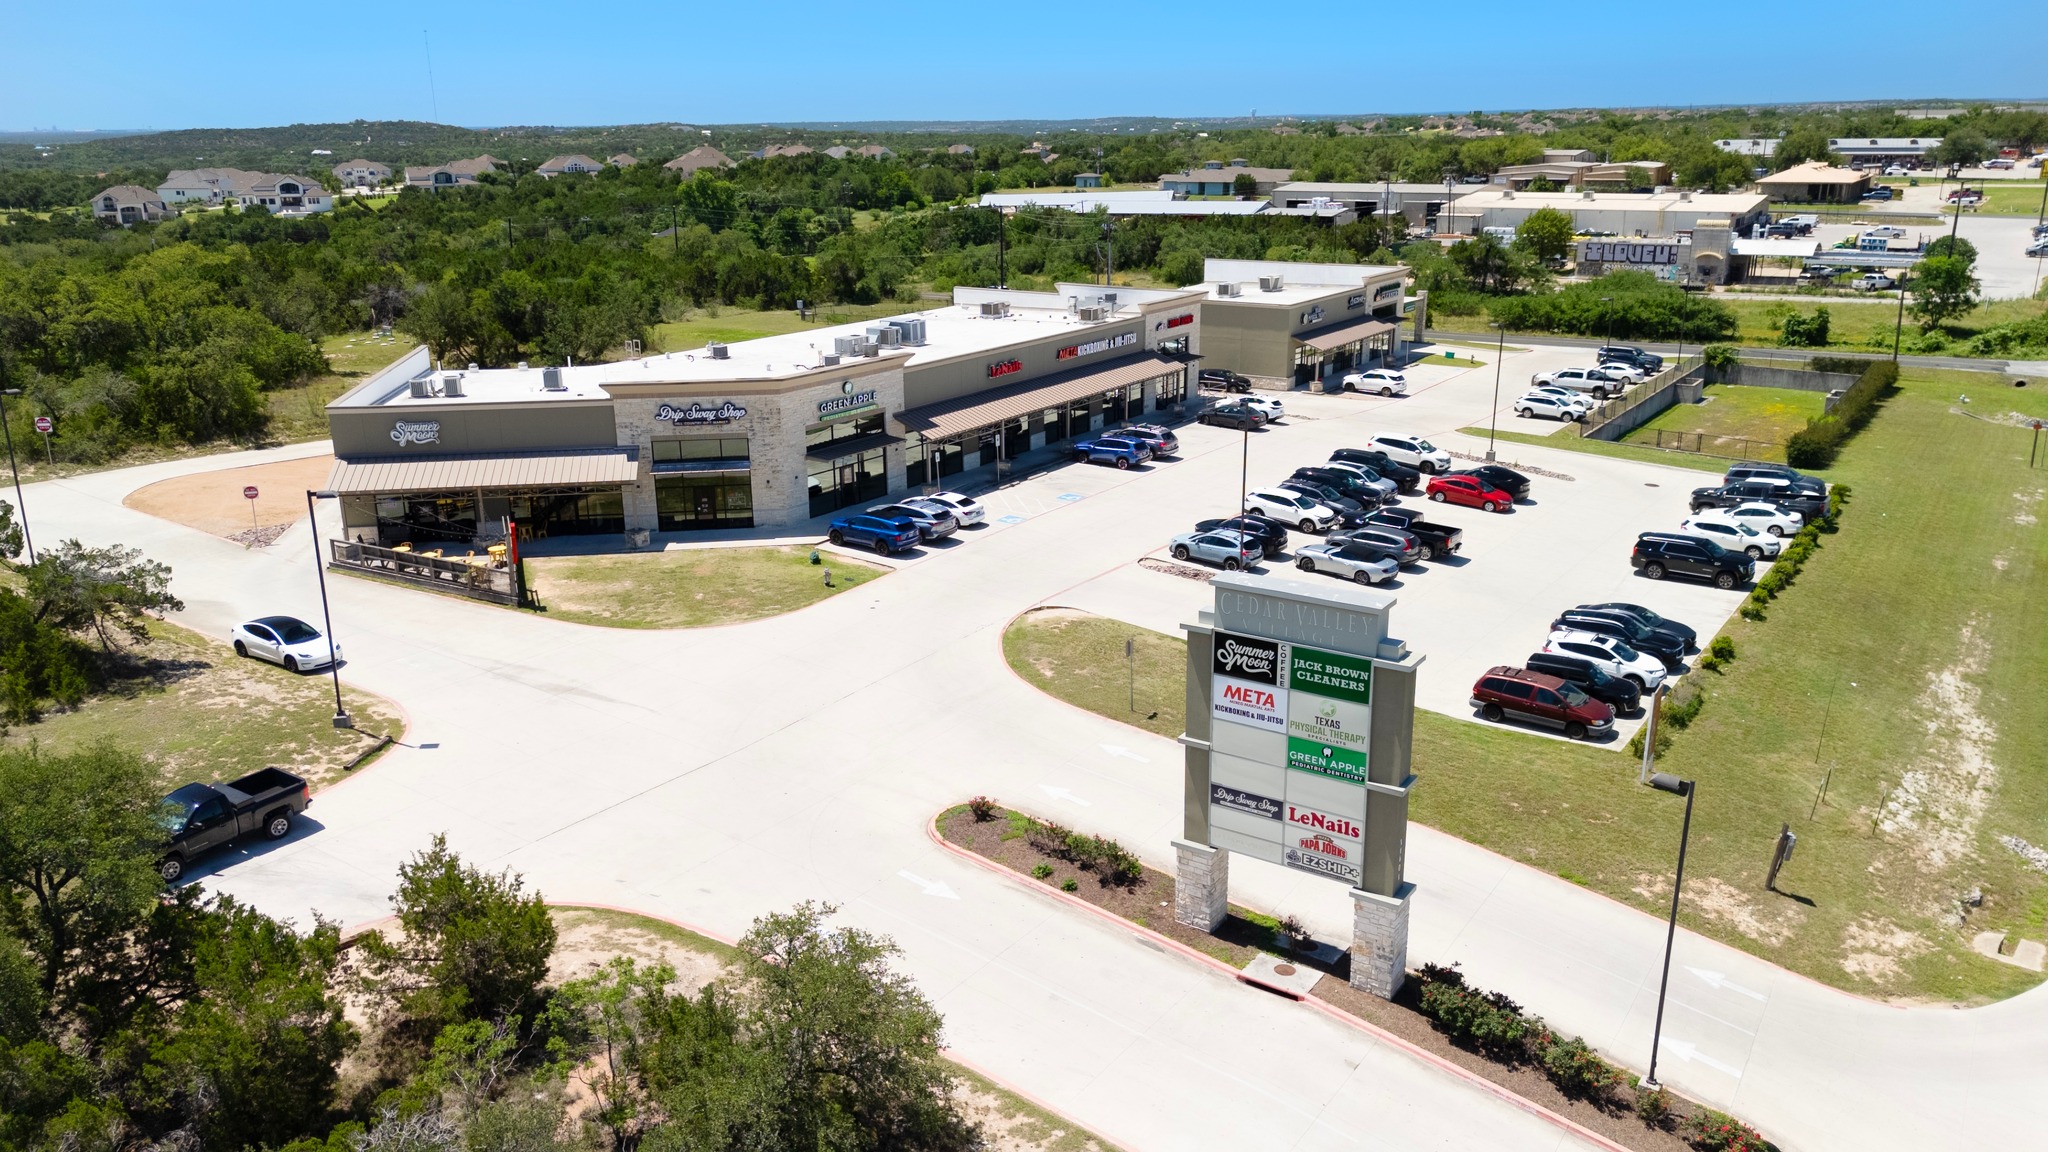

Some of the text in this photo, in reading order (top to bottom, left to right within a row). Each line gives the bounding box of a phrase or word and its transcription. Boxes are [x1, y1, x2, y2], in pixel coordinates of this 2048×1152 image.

[1058, 346, 1078, 361] META
[655, 403, 746, 422] Drip Swag Shop
[820, 398, 850, 413] GREEN
[852, 391, 878, 405] APPLE
[390, 420, 440, 441] Summer
[399, 430, 440, 447] Moon
[1220, 592, 1373, 636] CEDAR VALLEY
[1216, 639, 1275, 664] Summer
[1225, 653, 1273, 678] Moon
[1279, 645, 1287, 687] COFFEE
[1293, 658, 1370, 681] JACK BROWN
[1296, 670, 1365, 692] CLEANERS
[1223, 684, 1275, 709] META
[1214, 703, 1251, 718] KICKBOXING
[1256, 713, 1284, 726] JIU-JITSU
[1314, 715, 1341, 730] TEXAS
[1289, 720, 1366, 745] PHYSICAL THERAPY
[1307, 733, 1347, 746] SPECIALISTS
[1289, 750, 1366, 776] GREEN APPLE
[1291, 760, 1363, 782] PEDIATRIC DENTISTRY
[1213, 788, 1235, 802] Drip
[1235, 793, 1258, 809] Swag
[1257, 799, 1279, 813] Shop
[1288, 806, 1360, 839] LeNails
[1300, 839, 1347, 859] PAPA JOHNS
[1302, 853, 1360, 878] EZSHIP+
